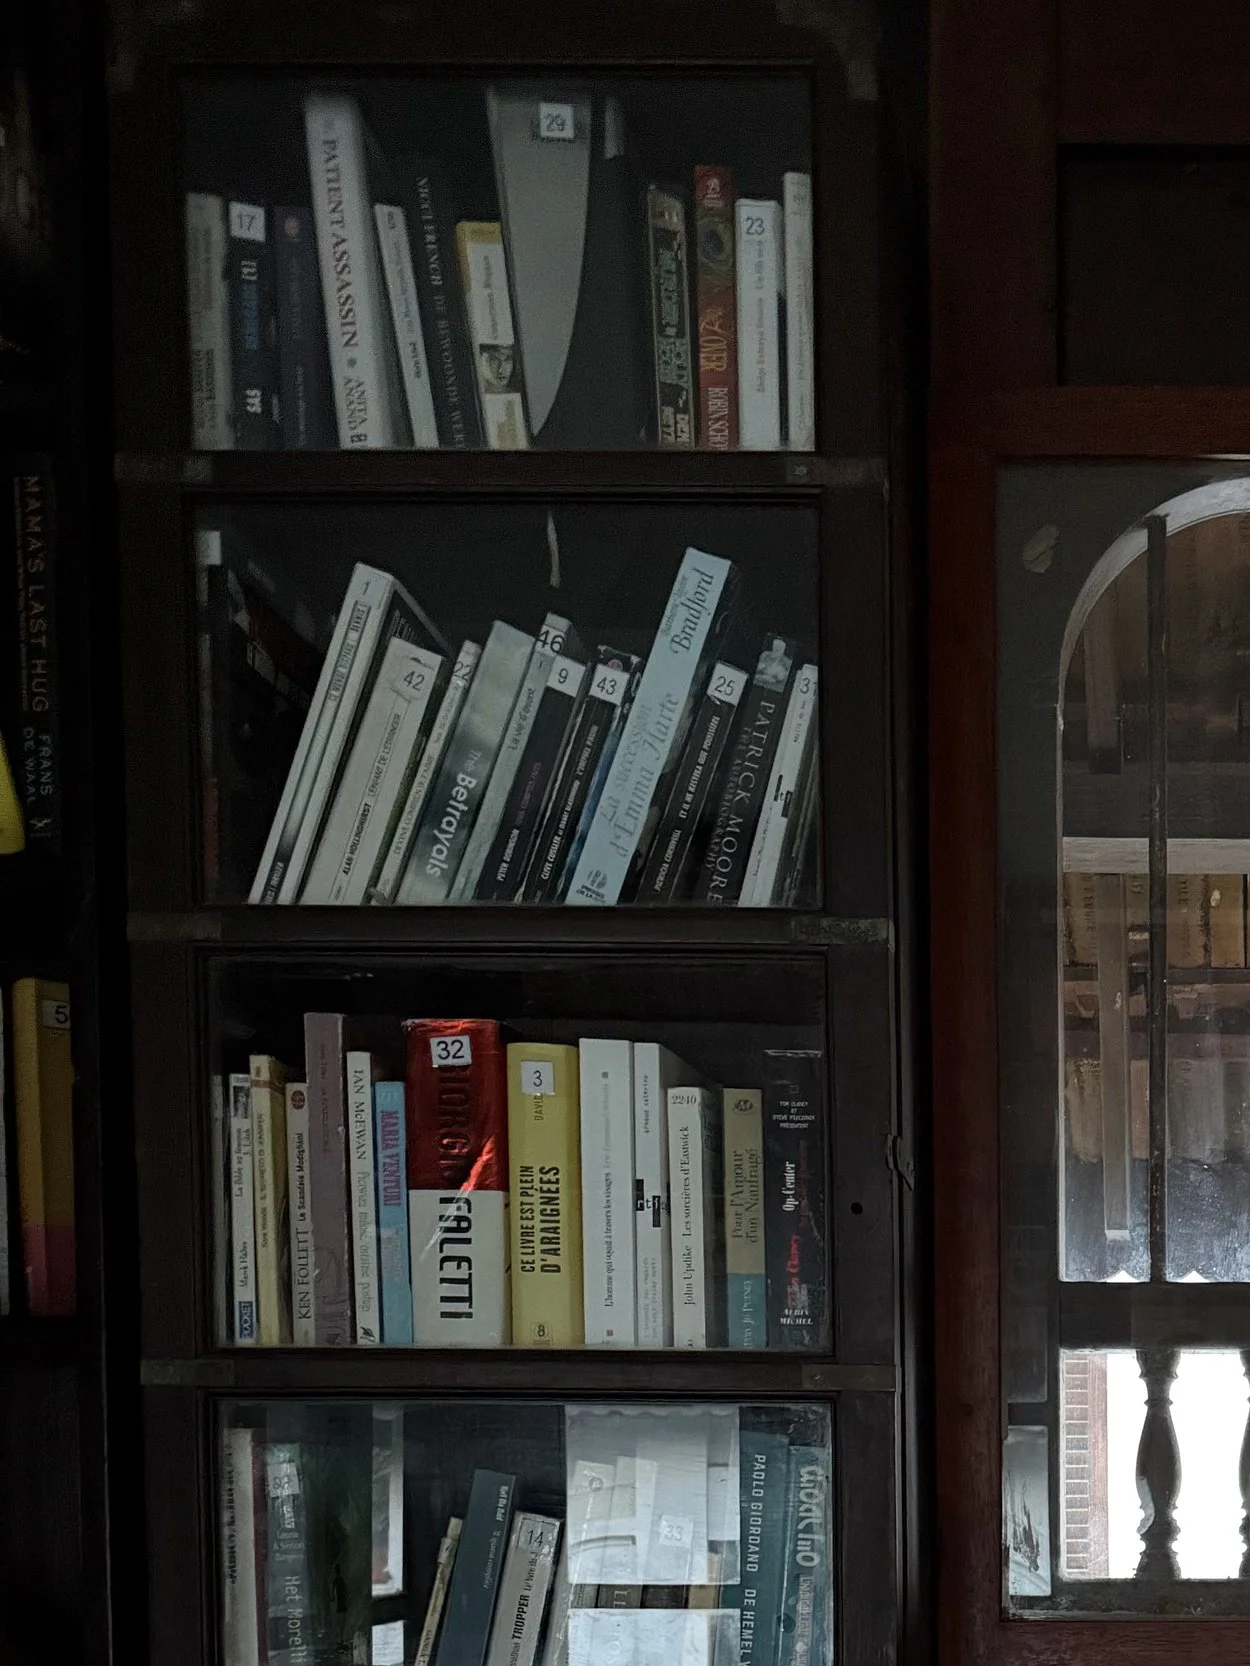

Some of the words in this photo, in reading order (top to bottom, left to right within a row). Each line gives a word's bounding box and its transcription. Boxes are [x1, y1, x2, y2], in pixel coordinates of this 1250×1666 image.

[331, 231, 360, 350] ASSASSIN
[28, 584, 48, 649] LAST
[669, 564, 717, 653] Bradford
[31, 657, 49, 714] HUG
[403, 670, 426, 690] 42
[597, 677, 619, 695] 43
[714, 675, 738, 698] 25
[734, 699, 776, 799] PATRICK
[425, 773, 479, 880] Betrayals
[708, 812, 744, 905] MOORE
[436, 1039, 465, 1059] 32
[354, 1100, 368, 1160] McEWAN
[380, 1109, 401, 1149] MARIA
[518, 1165, 533, 1199] PLEIN
[782, 1160, 799, 1212] Op-Center
[519, 1201, 533, 1221] EST
[534, 1166, 561, 1274] D'ARAIGNÉES
[295, 1227, 311, 1286] FOLLETT
[439, 1196, 473, 1319] FALETTI
[520, 1224, 534, 1256] LIVRE
[297, 1291, 313, 1321] KEN
[751, 1454, 767, 1498] PAOLO
[746, 1502, 764, 1573] GIORDANO
[284, 1575, 301, 1603] Het
[511, 1594, 530, 1641] TROPPER
[739, 1610, 756, 1656] HEMEL
